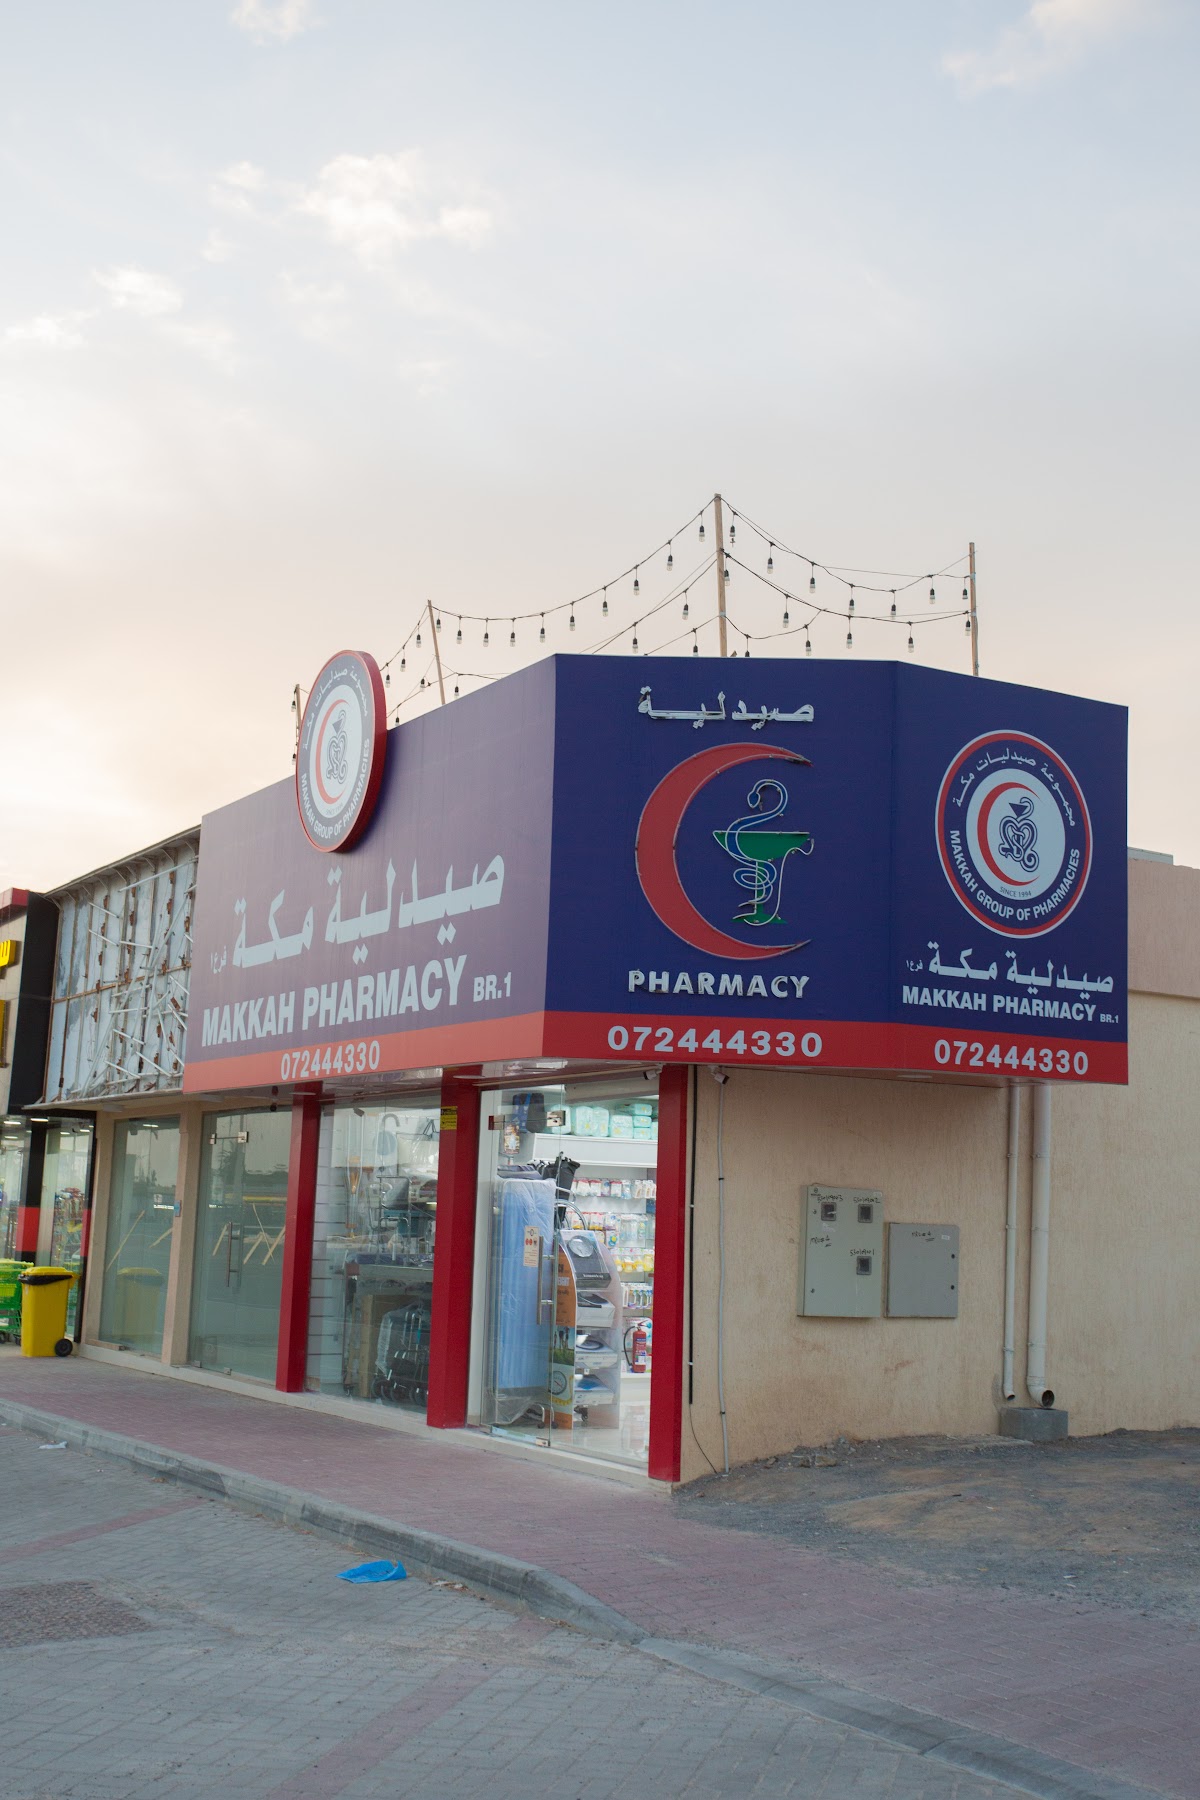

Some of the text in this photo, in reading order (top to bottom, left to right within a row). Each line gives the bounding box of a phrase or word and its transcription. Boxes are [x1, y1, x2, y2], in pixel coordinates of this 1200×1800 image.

[638, 686, 815, 731] صيدلية
[301, 738, 370, 839] MAKKAH GROUP OF PHARMACIES
[952, 772, 975, 807] مكة
[950, 830, 1080, 921] MAKKAH GROUP OF PHARMACIES
[1000, 886, 1017, 897] SINCE
[232, 889, 314, 969] مكة
[325, 855, 505, 966] صيدلية
[927, 941, 998, 981] مكة
[1005, 950, 1114, 1000] صيدلية
[202, 955, 512, 1047] MAKKAH PHARMACY BR.1
[628, 969, 810, 999] PHARMACY
[902, 985, 1119, 1024] MAKKAH PHARMACY BR.1
[281, 1040, 380, 1081] 072444330
[607, 1025, 823, 1057] 072444330
[934, 1039, 1089, 1075] 072444330
